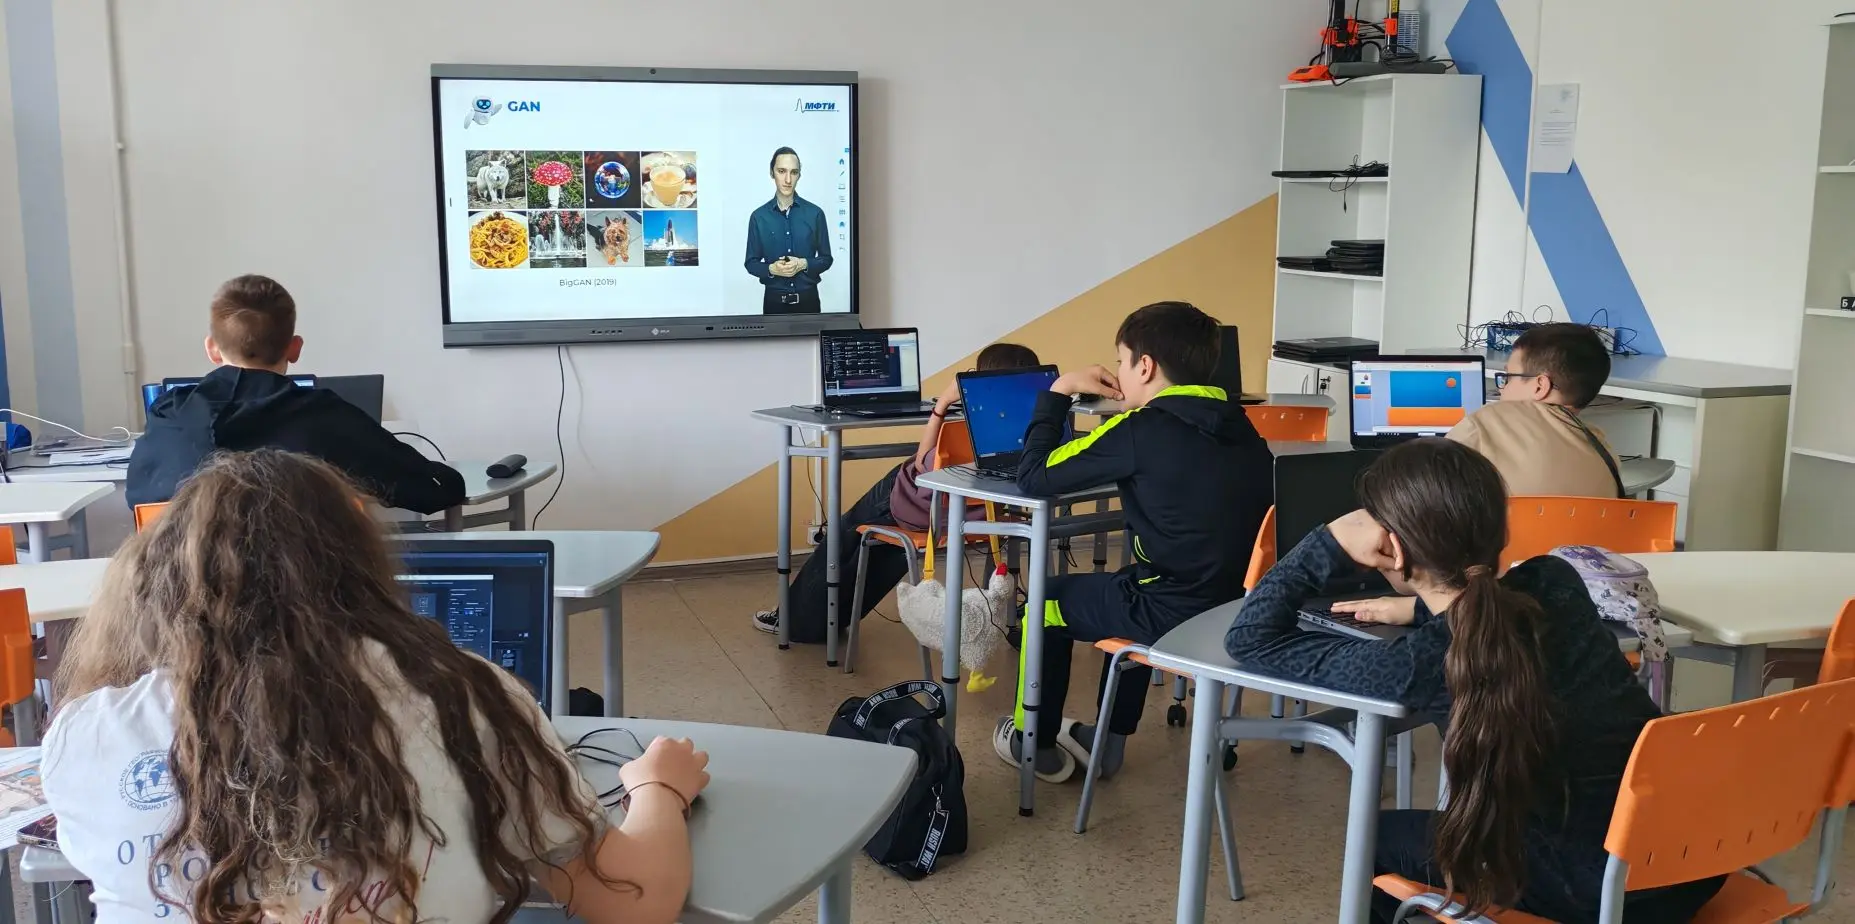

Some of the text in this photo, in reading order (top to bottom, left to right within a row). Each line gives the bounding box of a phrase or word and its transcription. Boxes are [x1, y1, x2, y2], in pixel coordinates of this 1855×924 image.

[507, 100, 541, 112] GAN
[804, 102, 836, 110] МФТИ
[559, 278, 617, 287] BigGAN (2019)
[868, 694, 884, 707] WAY
[920, 827, 941, 868] RUSH WAY
